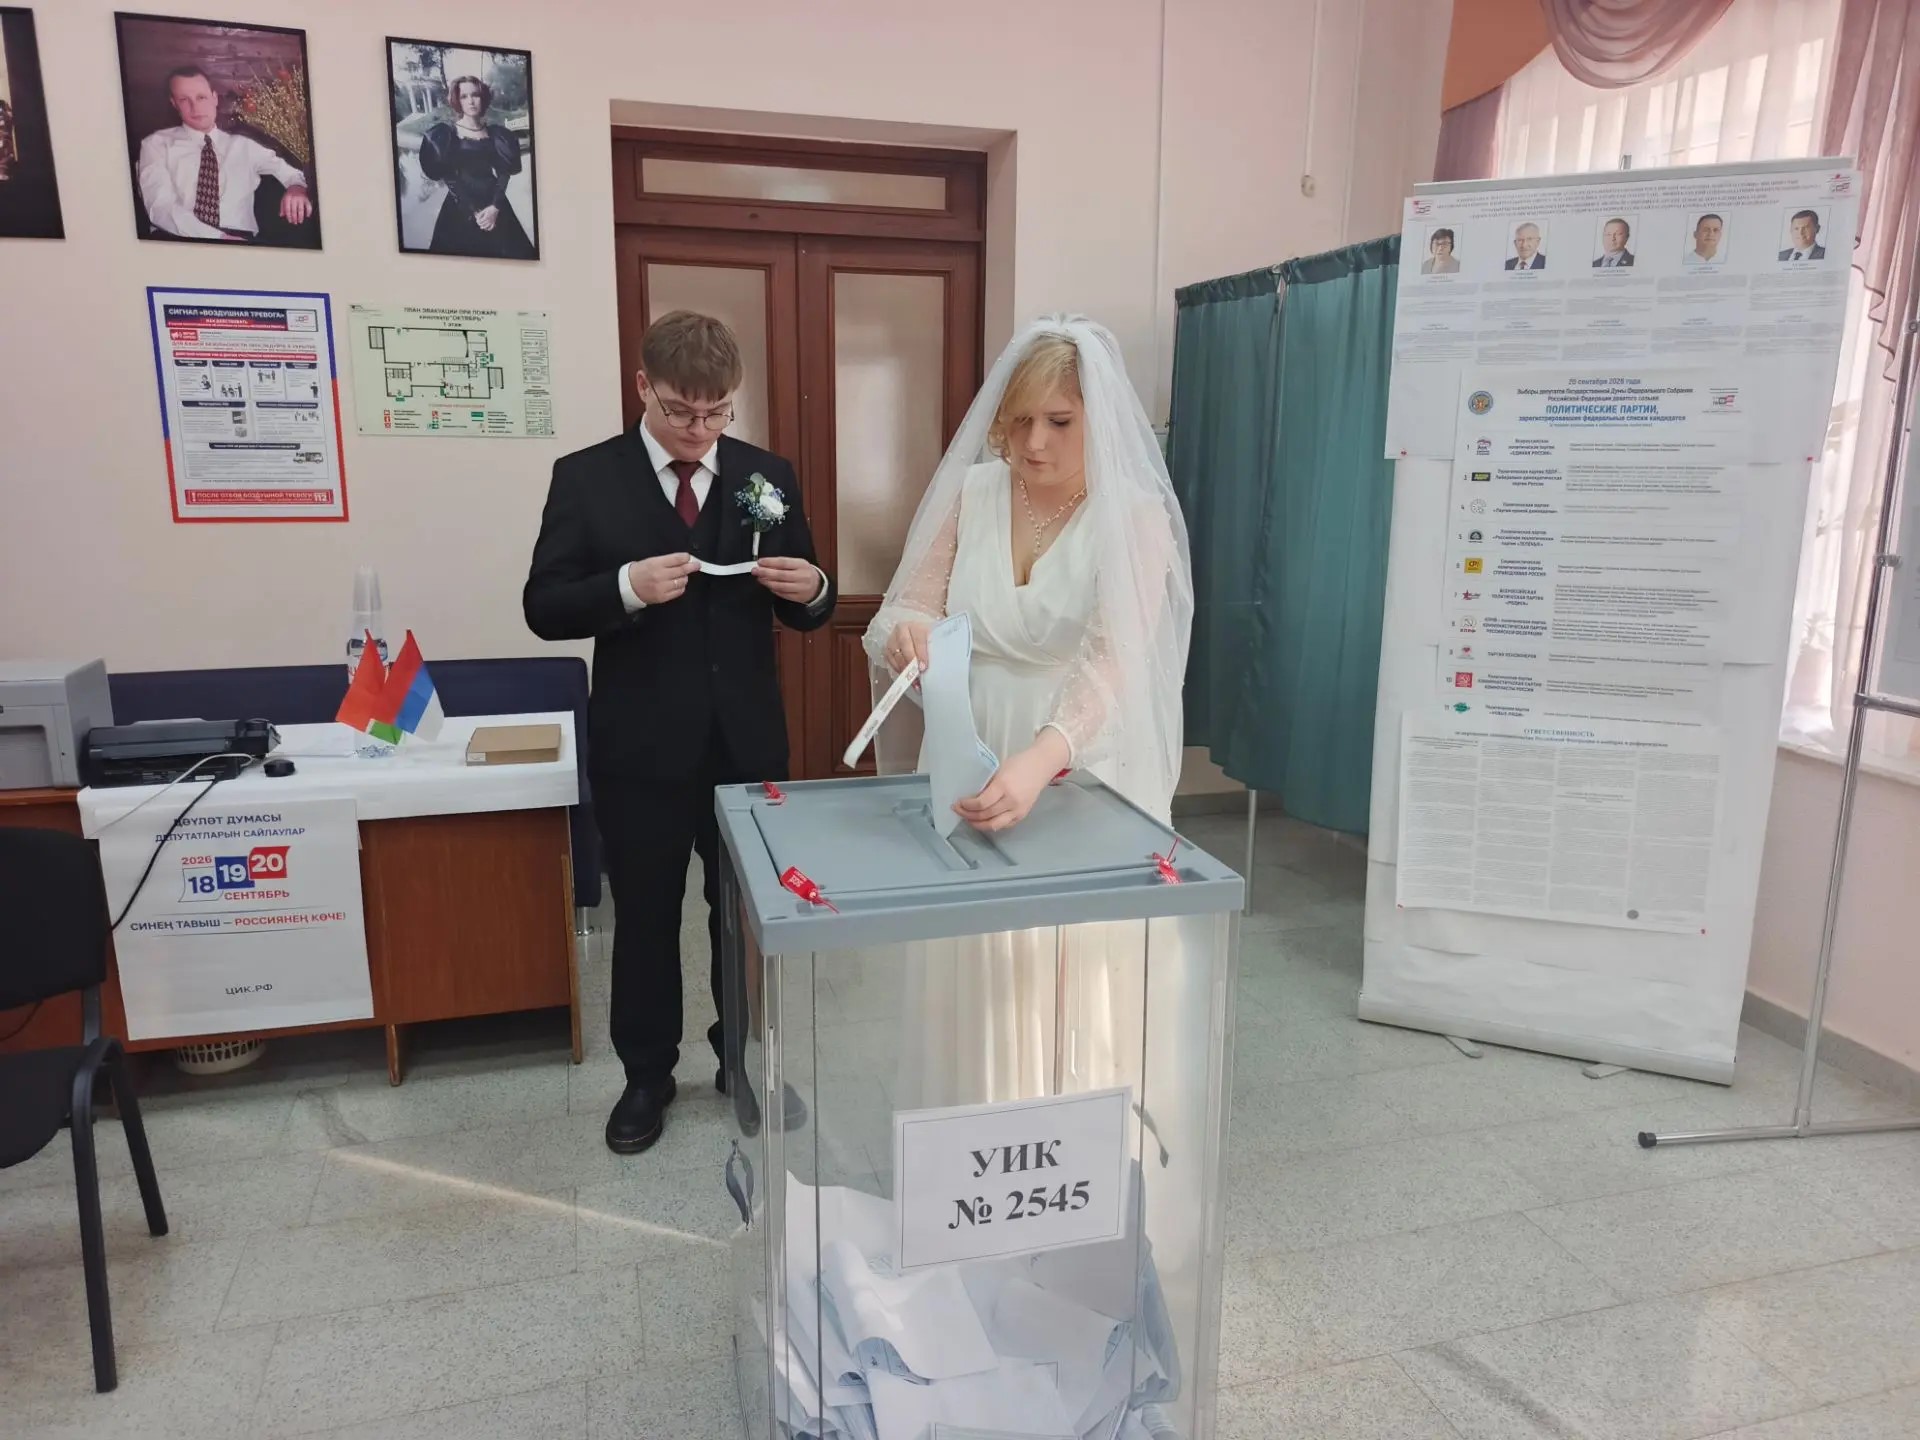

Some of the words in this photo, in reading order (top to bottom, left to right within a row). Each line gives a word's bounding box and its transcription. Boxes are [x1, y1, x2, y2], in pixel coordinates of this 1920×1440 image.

[1546, 404, 1617, 414] ПОЛИТИЧЕСКИЕ
[226, 814, 281, 825] ДУМАСЫ
[243, 828, 305, 837] САЙЛАУЛАР
[181, 856, 212, 865] 2026
[251, 853, 284, 872] 20
[219, 864, 247, 883] 19
[188, 876, 215, 894] 18
[224, 890, 290, 900] СЕНТЯБРЬ
[177, 919, 221, 929] ТАВЫШ
[226, 984, 273, 995] ЦИК.РФ
[970, 1140, 1061, 1178] УИК
[948, 1196, 992, 1229] №
[1005, 1180, 1090, 1220] 2545
